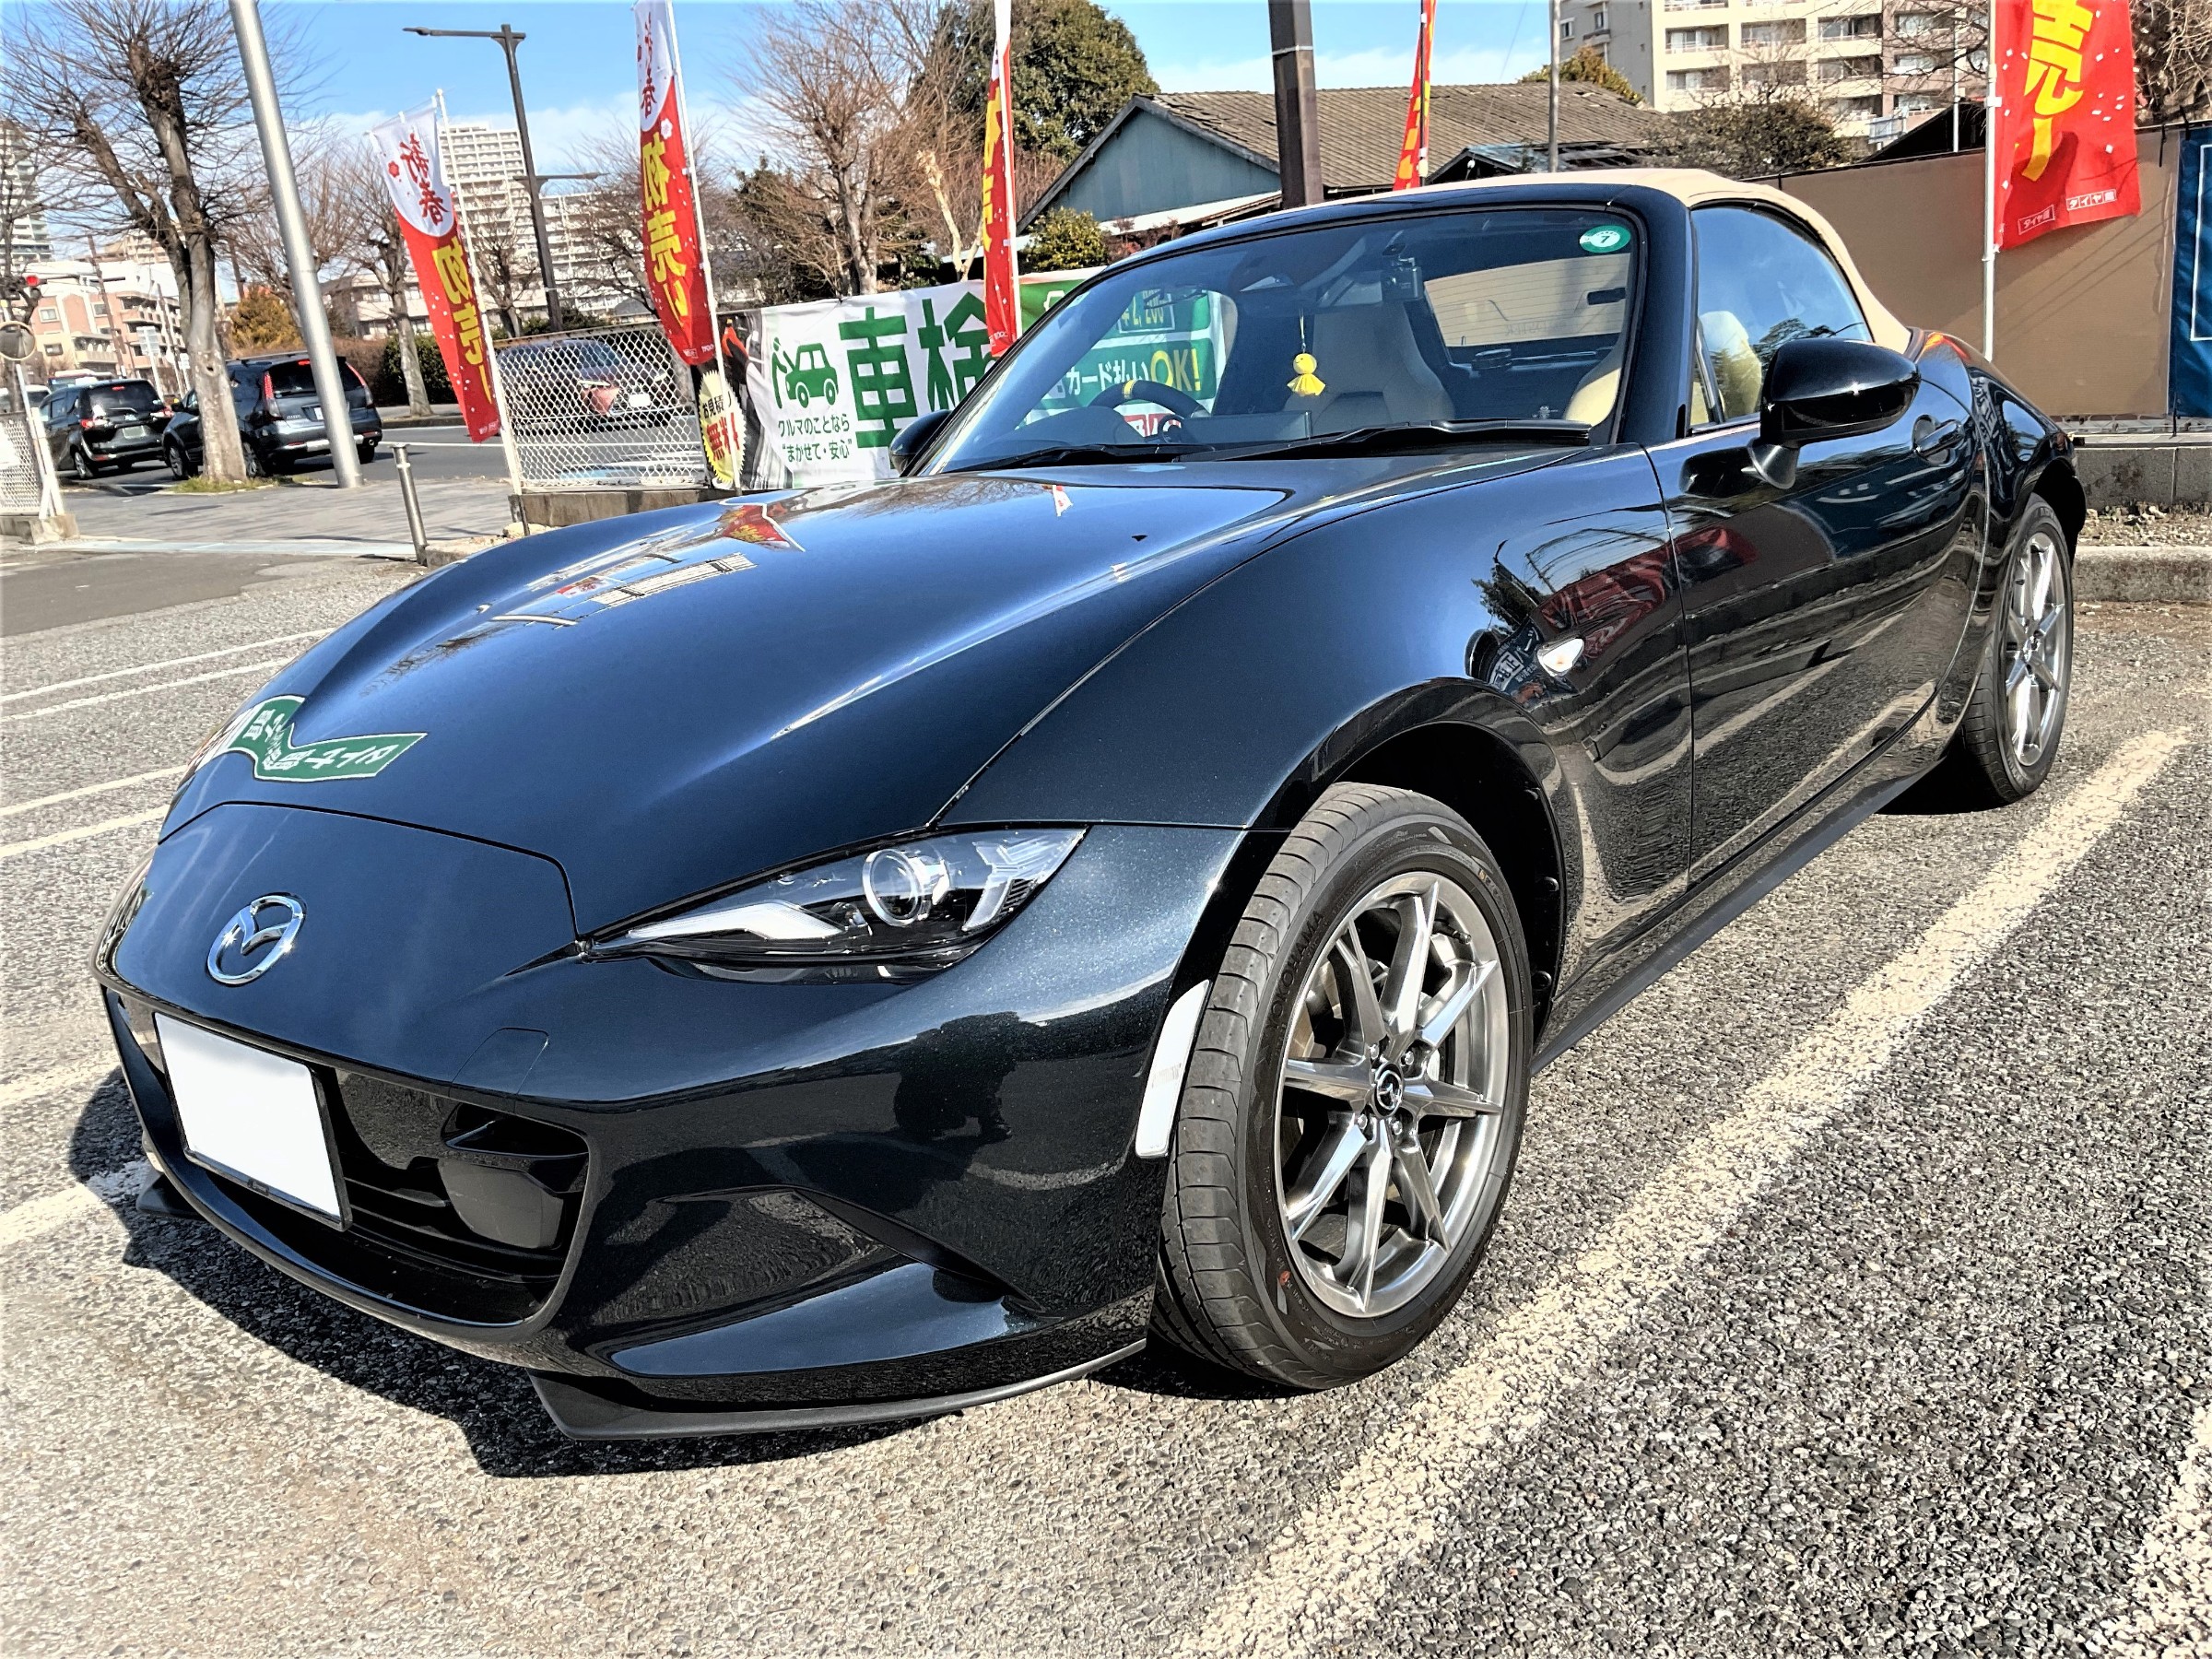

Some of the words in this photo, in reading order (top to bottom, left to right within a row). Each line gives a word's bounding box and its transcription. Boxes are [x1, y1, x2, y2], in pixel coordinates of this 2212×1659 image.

[779, 413, 850, 437] クルマのことなら
